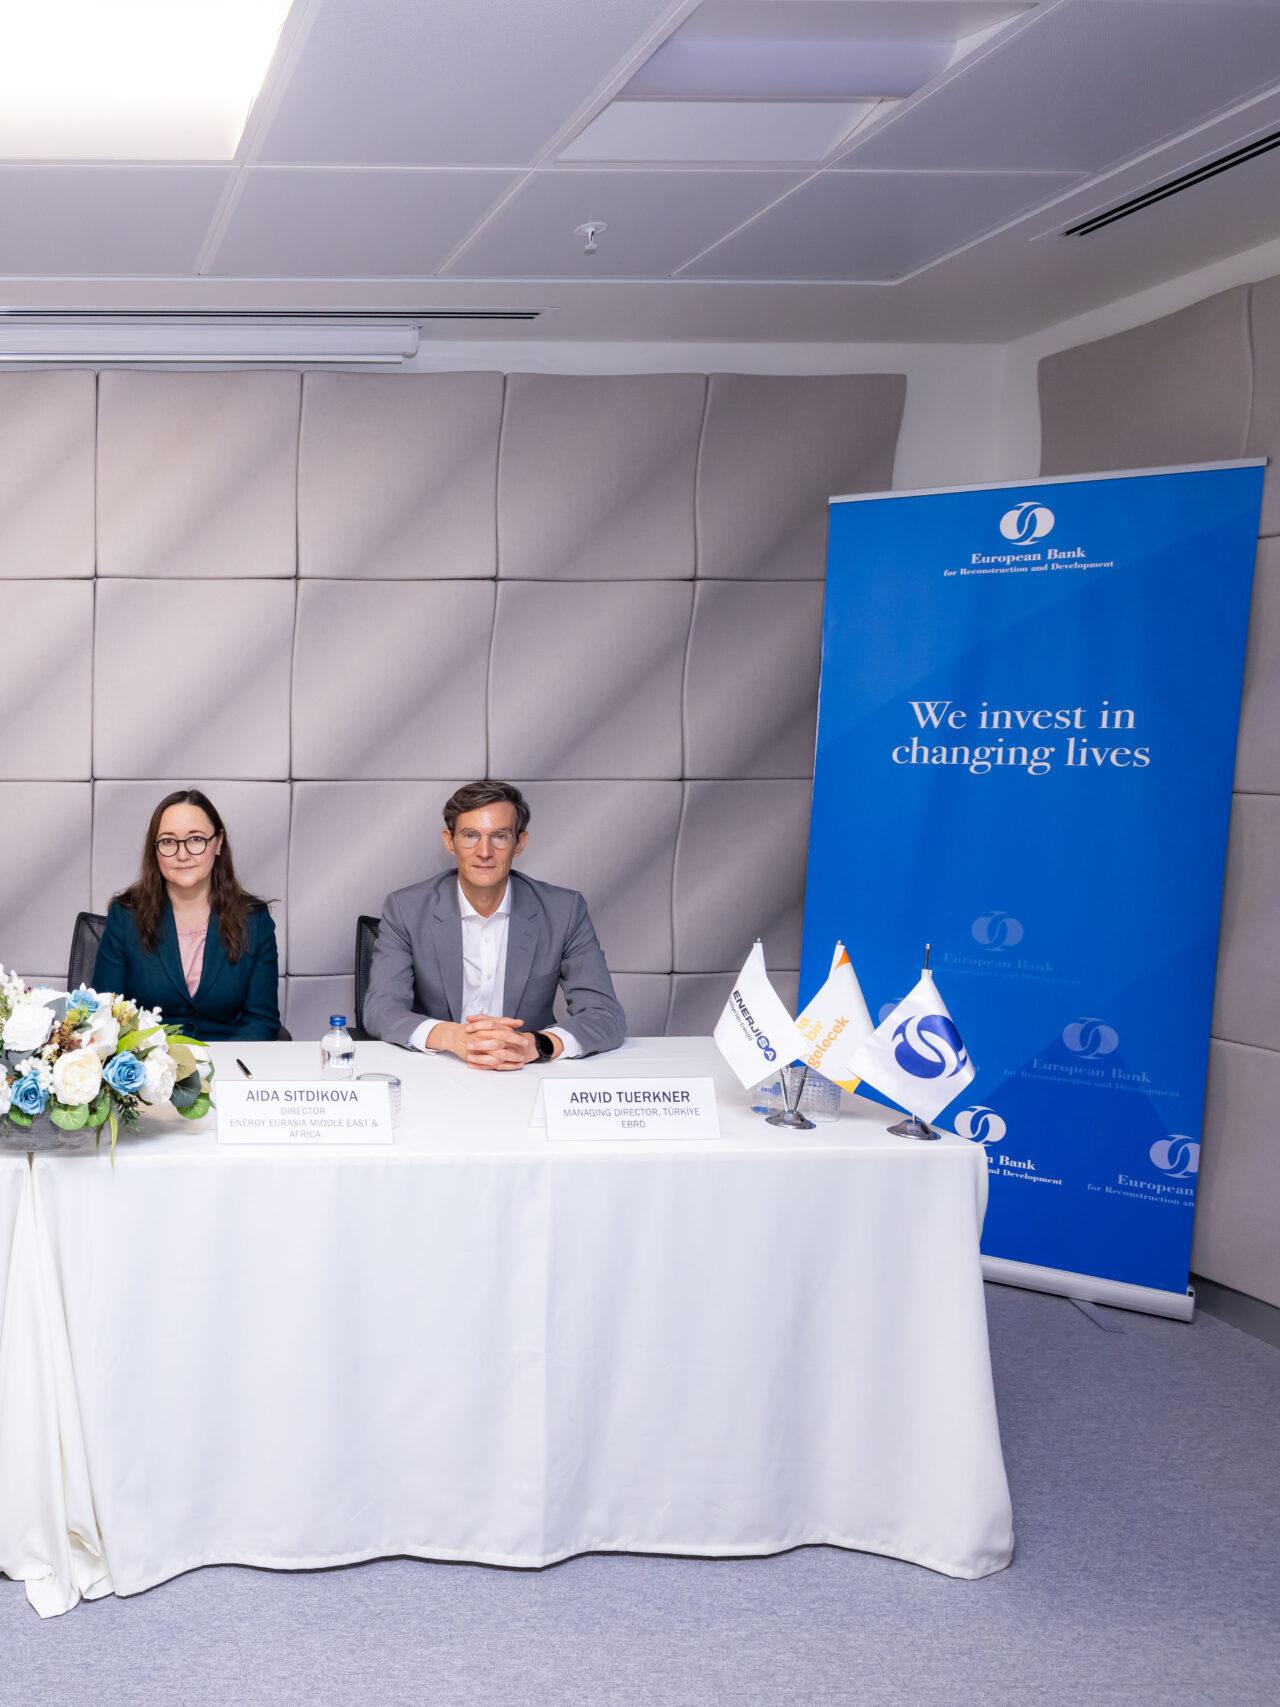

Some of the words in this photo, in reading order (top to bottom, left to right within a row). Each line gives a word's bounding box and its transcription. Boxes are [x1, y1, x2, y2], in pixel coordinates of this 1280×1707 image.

[971, 552, 1041, 565] European
[1047, 547, 1086, 560] Bank
[944, 569, 957, 577] for
[960, 566, 1028, 576] Reconstruction
[1030, 564, 1048, 572] and
[1051, 561, 1114, 571] Development
[908, 701, 967, 730] We
[978, 702, 1087, 730] invest
[1098, 700, 1136, 729] in
[892, 737, 1055, 776] changing
[1064, 737, 1150, 768] lives
[807, 1016, 850, 1070] gelecek
[1033, 1058, 1105, 1078] European
[1111, 1067, 1151, 1083] Bank
[246, 1090, 280, 1102] AIDA
[284, 1090, 359, 1102] SITDIKOVA
[570, 1092, 613, 1103] ARVID
[616, 1091, 690, 1103] TUERKNER
[280, 1107, 326, 1116] DIRECTOR
[563, 1108, 612, 1117] MANAGING
[614, 1108, 660, 1117] DIRECTOR,
[230, 1118, 266, 1127] ENERGY
[269, 1118, 307, 1127] EURASIA
[309, 1118, 344, 1127] MIDDLE
[347, 1118, 369, 1127] EAST
[621, 1120, 646, 1128] EBRD
[289, 1130, 321, 1138] AFRICA
[999, 1154, 1036, 1170] Bank
[1003, 1169, 1062, 1185] Development
[1117, 1174, 1194, 1197] European
[1087, 1183, 1102, 1192] for
[1105, 1185, 1180, 1205] Reconstruction
[1183, 1200, 1195, 1208] an
